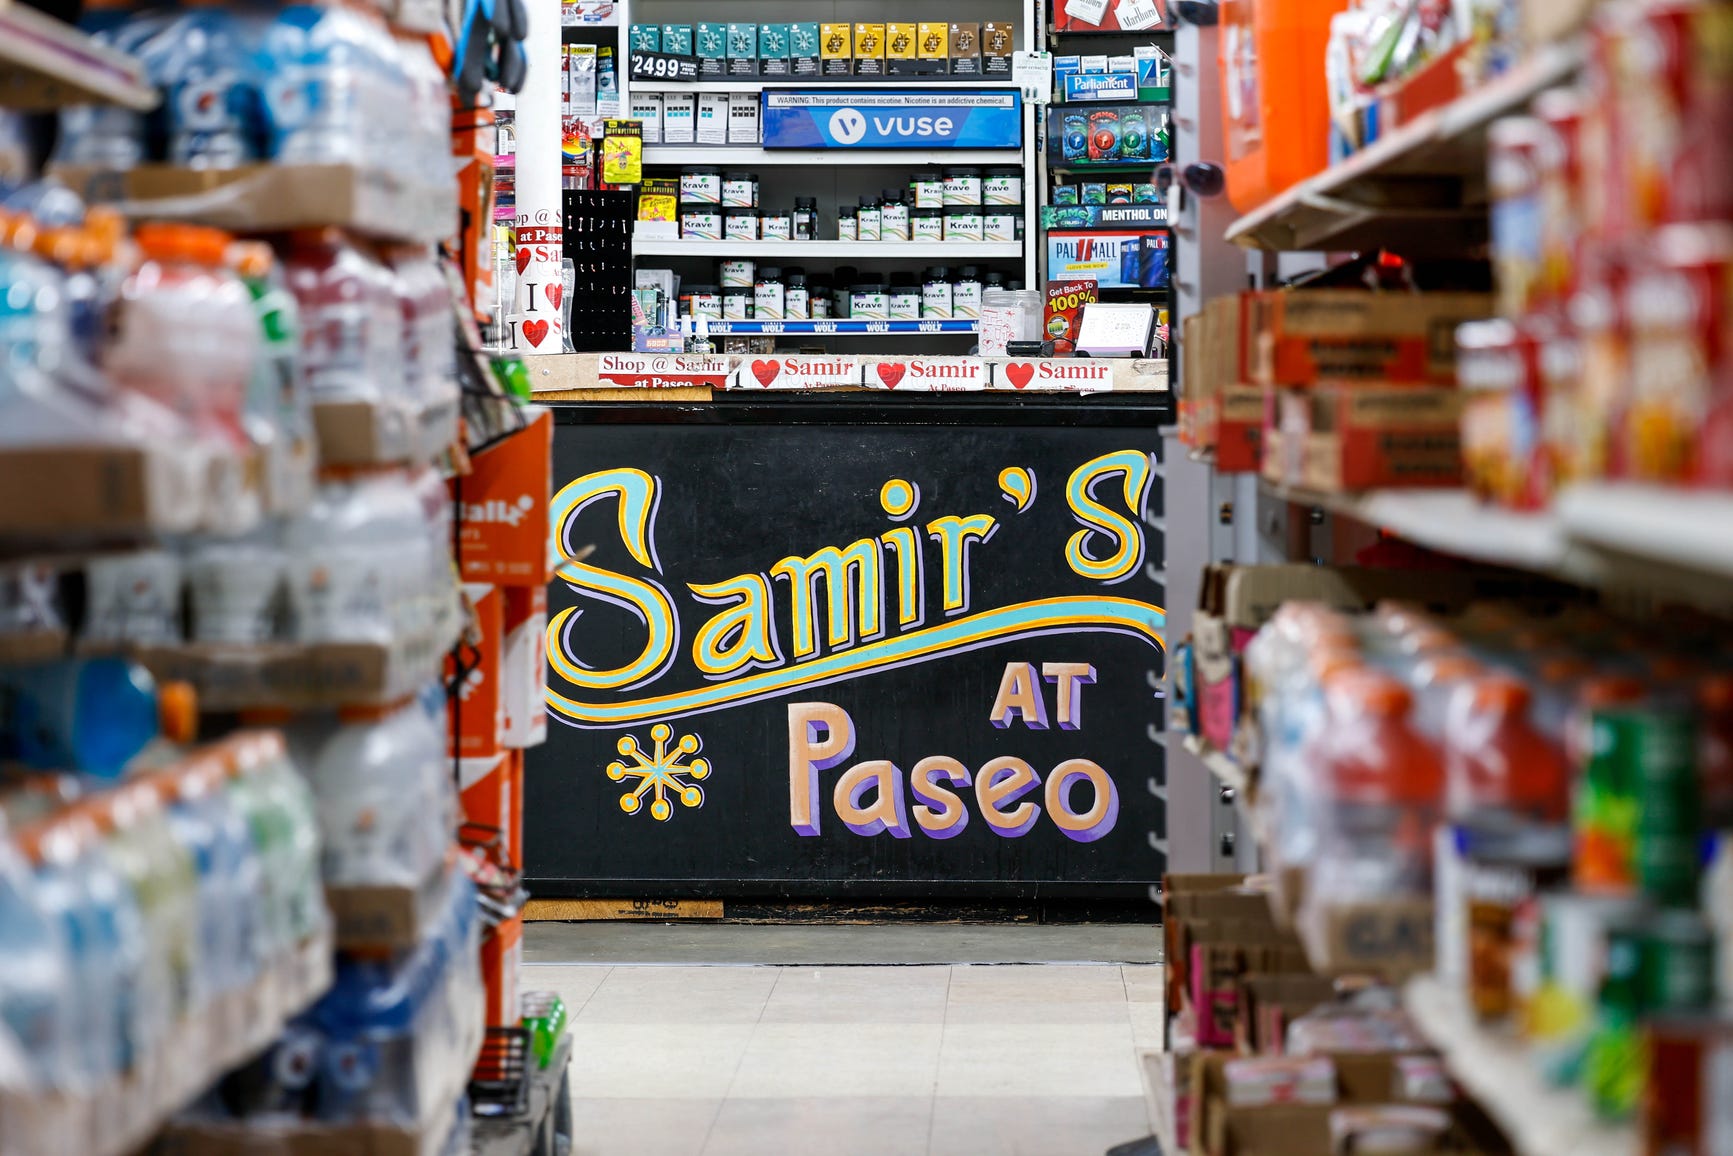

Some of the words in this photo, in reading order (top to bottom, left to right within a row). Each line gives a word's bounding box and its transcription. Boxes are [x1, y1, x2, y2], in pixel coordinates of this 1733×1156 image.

[1123, 7, 1157, 27] Marlboro
[1074, 76, 1128, 90] Parliament
[826, 97, 849, 105] product
[873, 116, 953, 136] vuse
[535, 208, 550, 225] @
[1049, 208, 1095, 224] CAMEL
[1102, 209, 1151, 221] MENTHOL
[684, 221, 713, 229] Krave
[520, 232, 532, 242] at
[1056, 242, 1080, 259] PALL
[1091, 242, 1117, 259] MALL
[526, 283, 538, 311] I
[1049, 288, 1063, 297] Get
[1064, 284, 1083, 294] Back
[1084, 281, 1094, 289] To
[1049, 289, 1096, 313] 100%
[508, 322, 519, 350] I
[709, 325, 733, 333] WOLF
[761, 325, 785, 333] WOLF
[813, 324, 838, 332] WOLF
[918, 324, 943, 332] WOLF
[603, 355, 645, 373] Shop
[652, 356, 669, 373] @
[784, 357, 854, 376] Samir
[910, 359, 979, 378] Samir
[1039, 361, 1109, 379] Samir
[928, 383, 938, 391] At
[941, 383, 966, 391] Paseo
[989, 661, 1097, 731] AT
[787, 702, 1120, 843] Paseo
